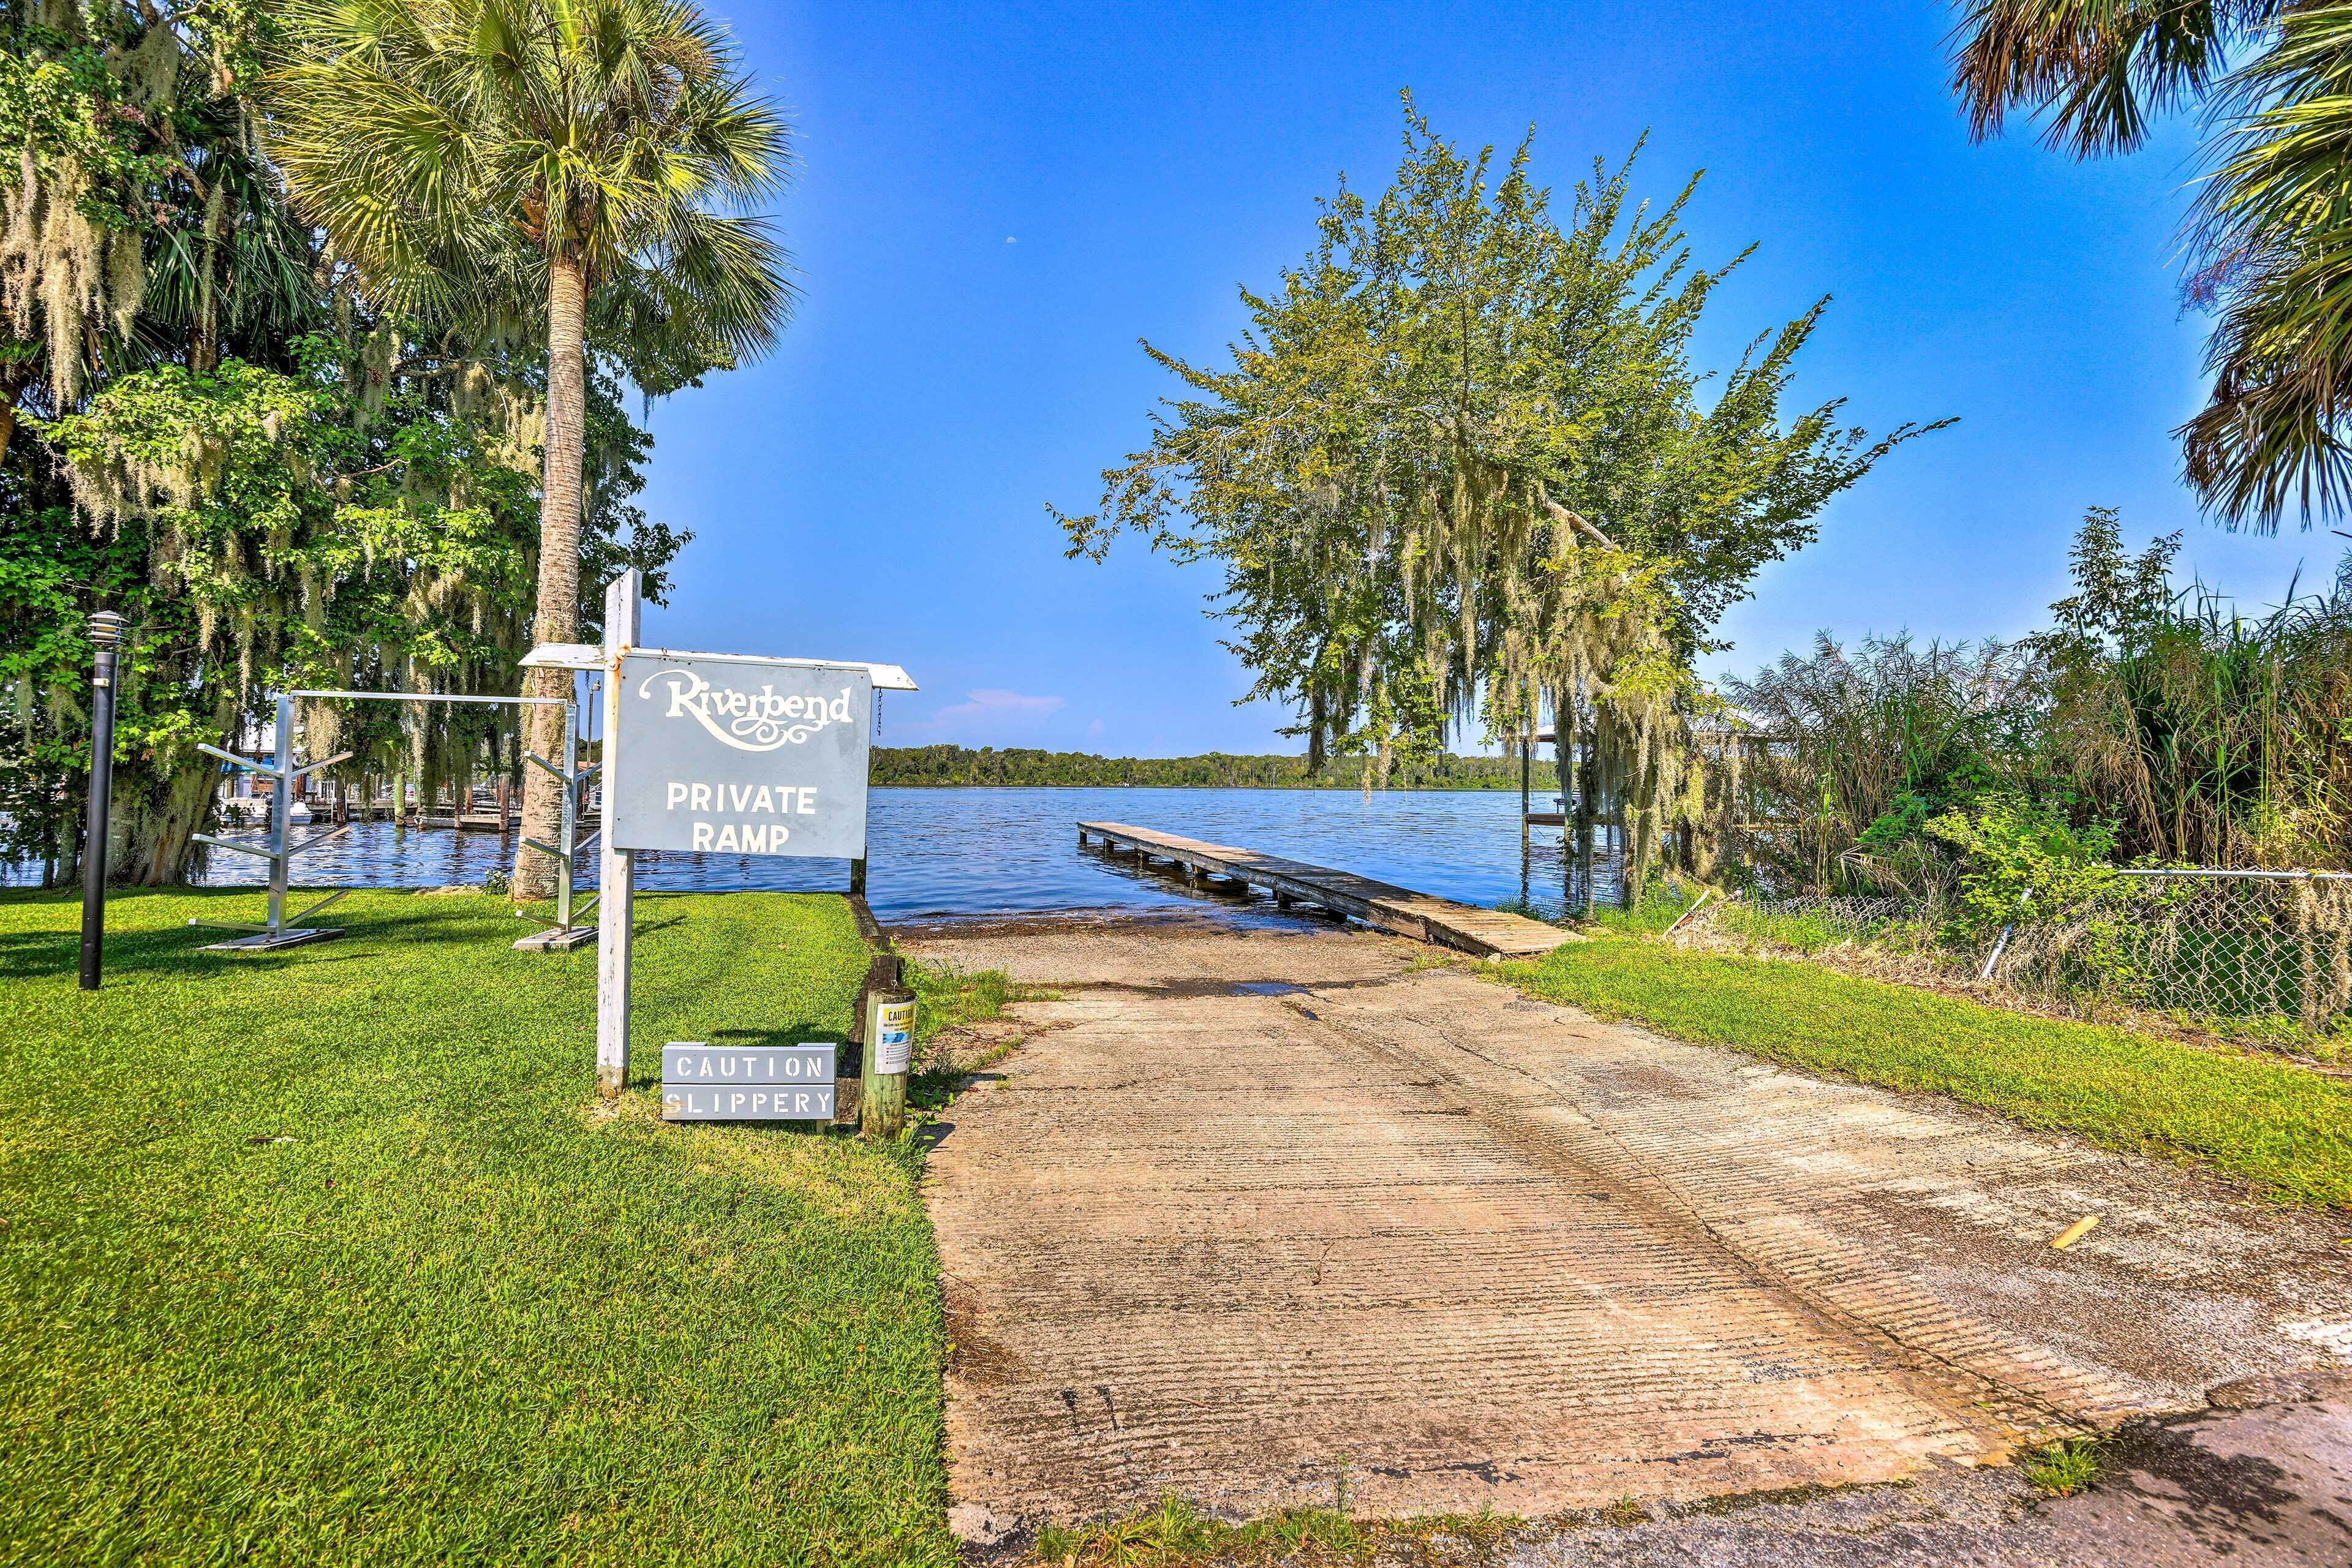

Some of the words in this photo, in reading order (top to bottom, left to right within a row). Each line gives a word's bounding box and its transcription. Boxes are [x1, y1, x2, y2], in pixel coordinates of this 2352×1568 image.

[639, 669, 853, 752] Riverbend
[666, 782, 818, 815] PRIVATE
[692, 822, 790, 853] RAMP
[677, 1057, 822, 1077] CAUTION
[665, 1093, 831, 1114] SLIPPERY
